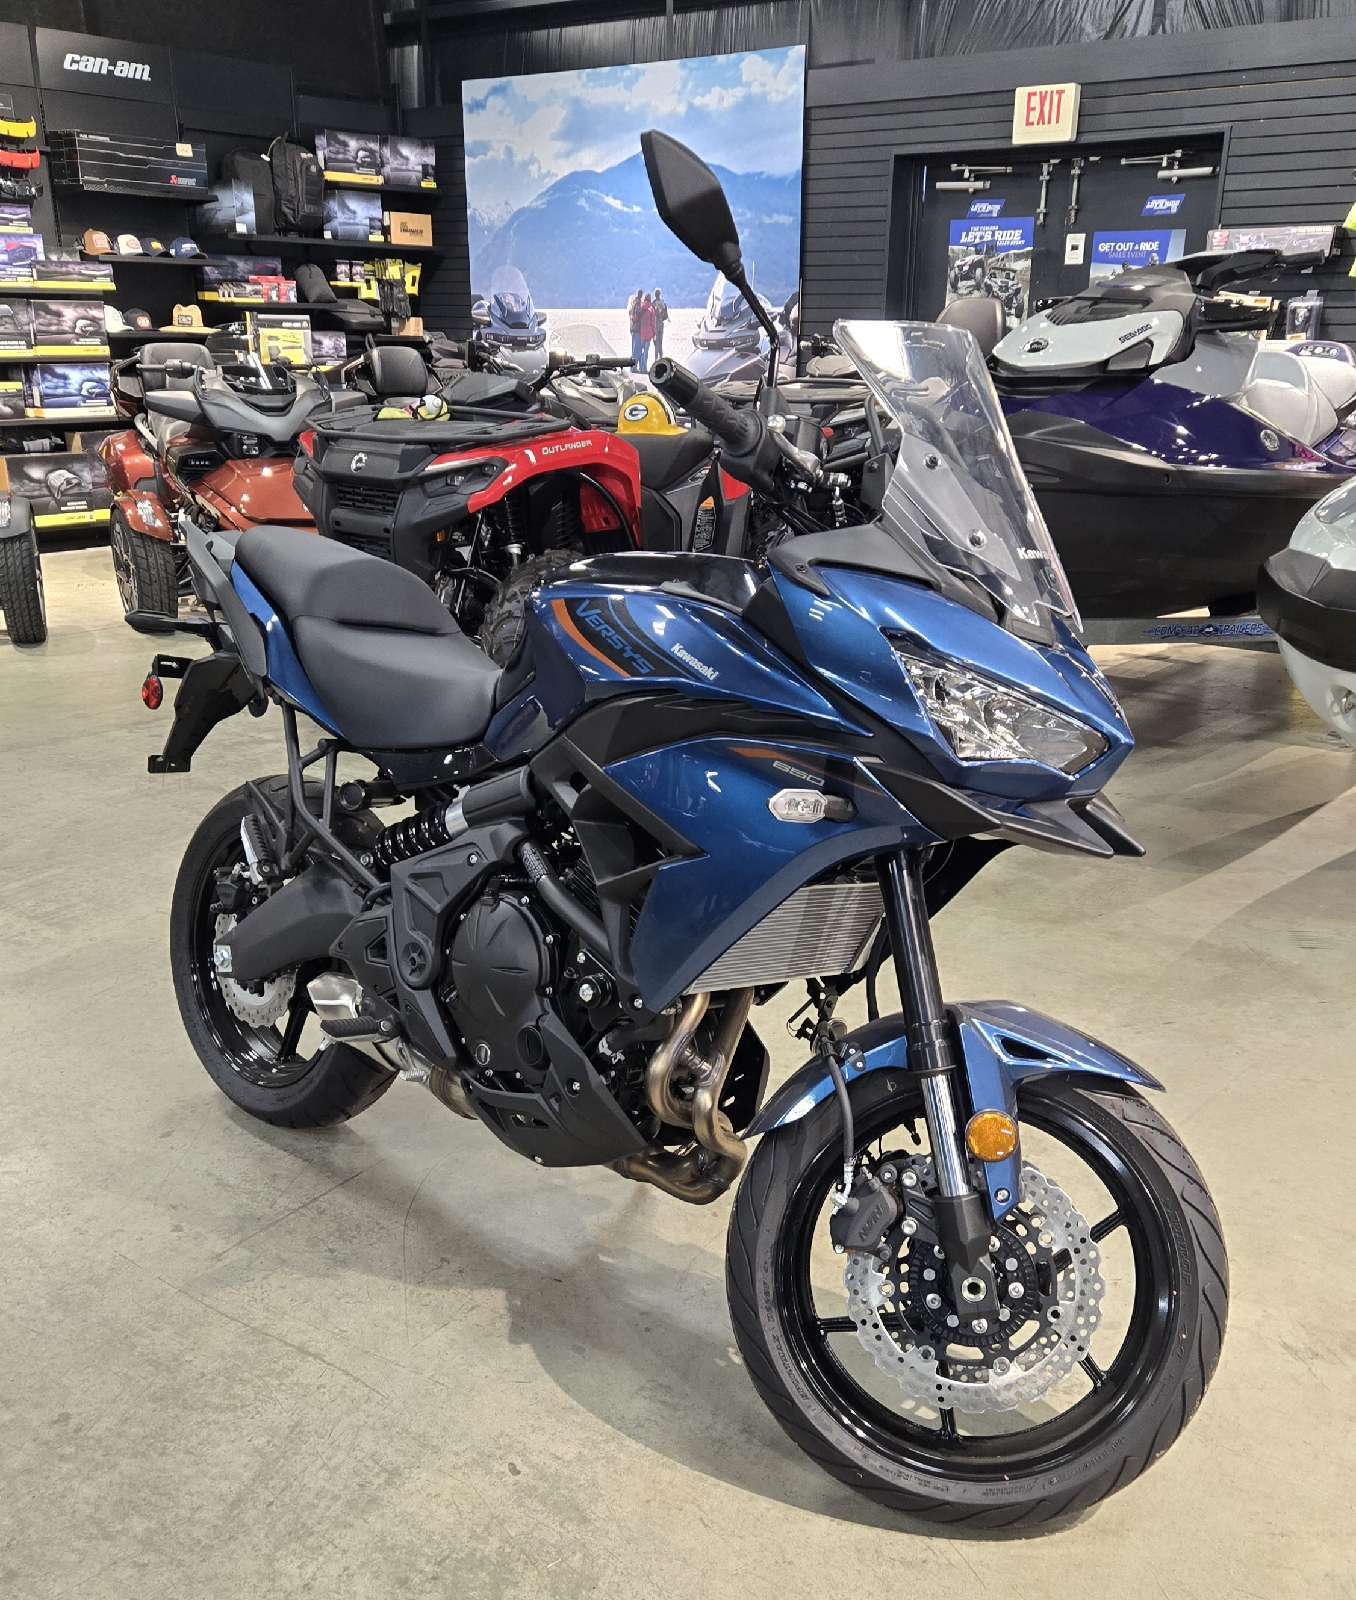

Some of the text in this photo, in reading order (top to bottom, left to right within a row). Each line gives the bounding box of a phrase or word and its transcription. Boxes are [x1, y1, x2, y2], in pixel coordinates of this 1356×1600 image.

[1025, 89, 1065, 127] EXIT
[960, 229, 1023, 244] LET'S RIDE
[1098, 242, 1115, 252] GET
[1115, 242, 1135, 251] OUT
[1139, 241, 1160, 251] RIDE
[542, 439, 593, 455] OUTLANDER
[575, 599, 656, 674] VERSYS
[670, 642, 720, 682] Kawasaki
[772, 760, 825, 787] 650
